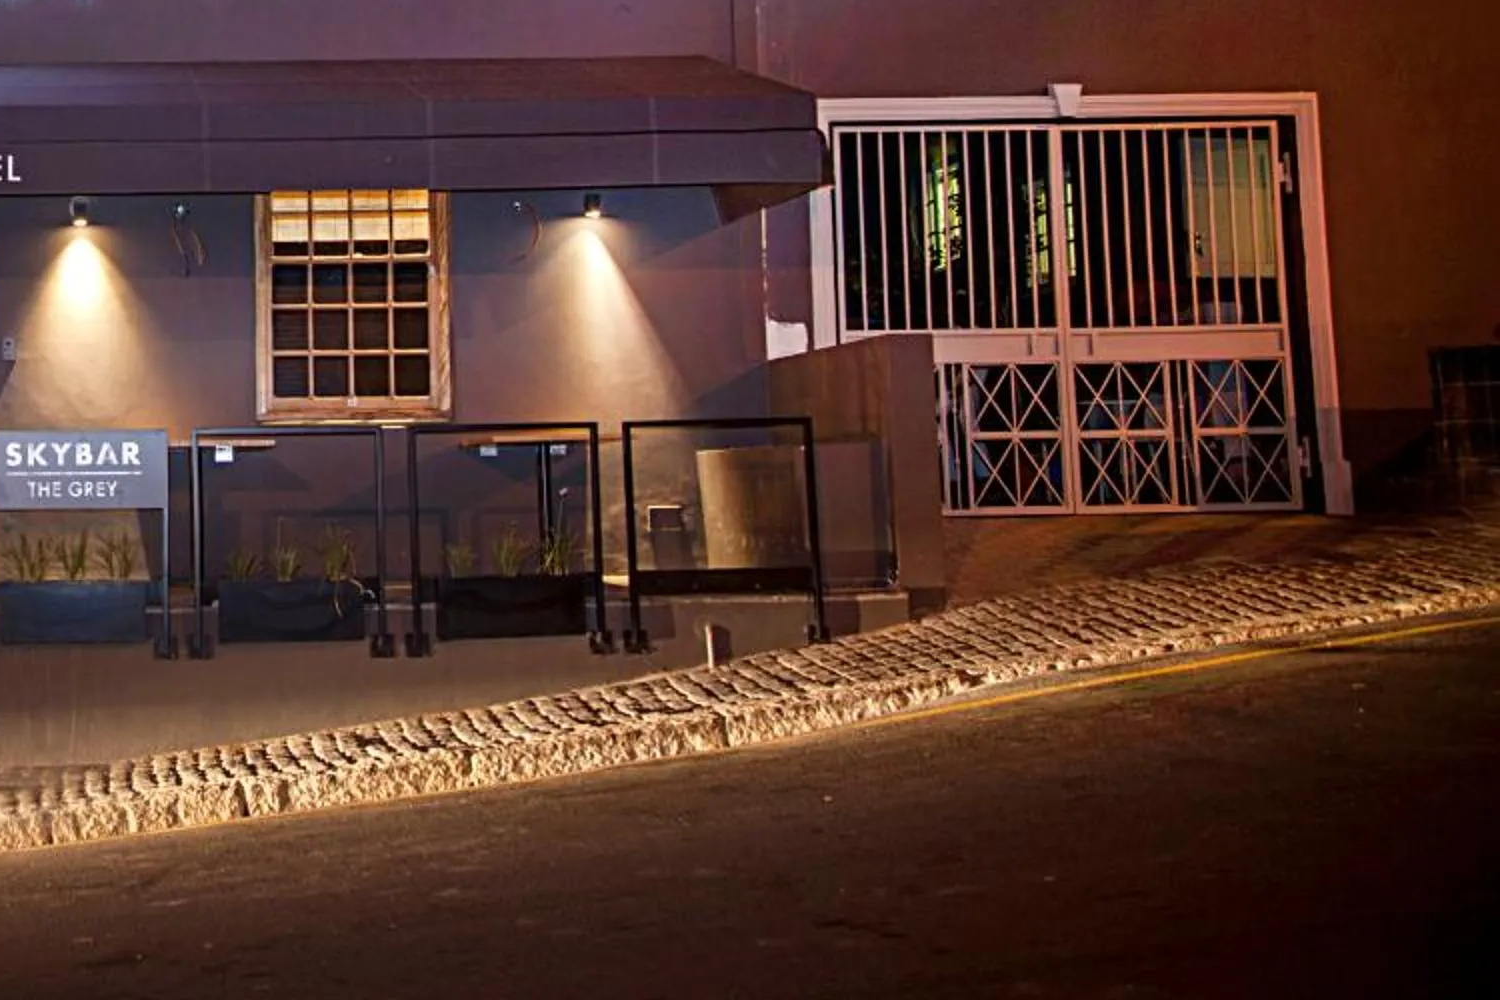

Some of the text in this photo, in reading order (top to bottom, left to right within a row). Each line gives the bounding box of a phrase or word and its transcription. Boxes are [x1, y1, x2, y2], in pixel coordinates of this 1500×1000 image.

[5, 441, 141, 468] SKYBAR
[26, 480, 118, 498] THE GREY
